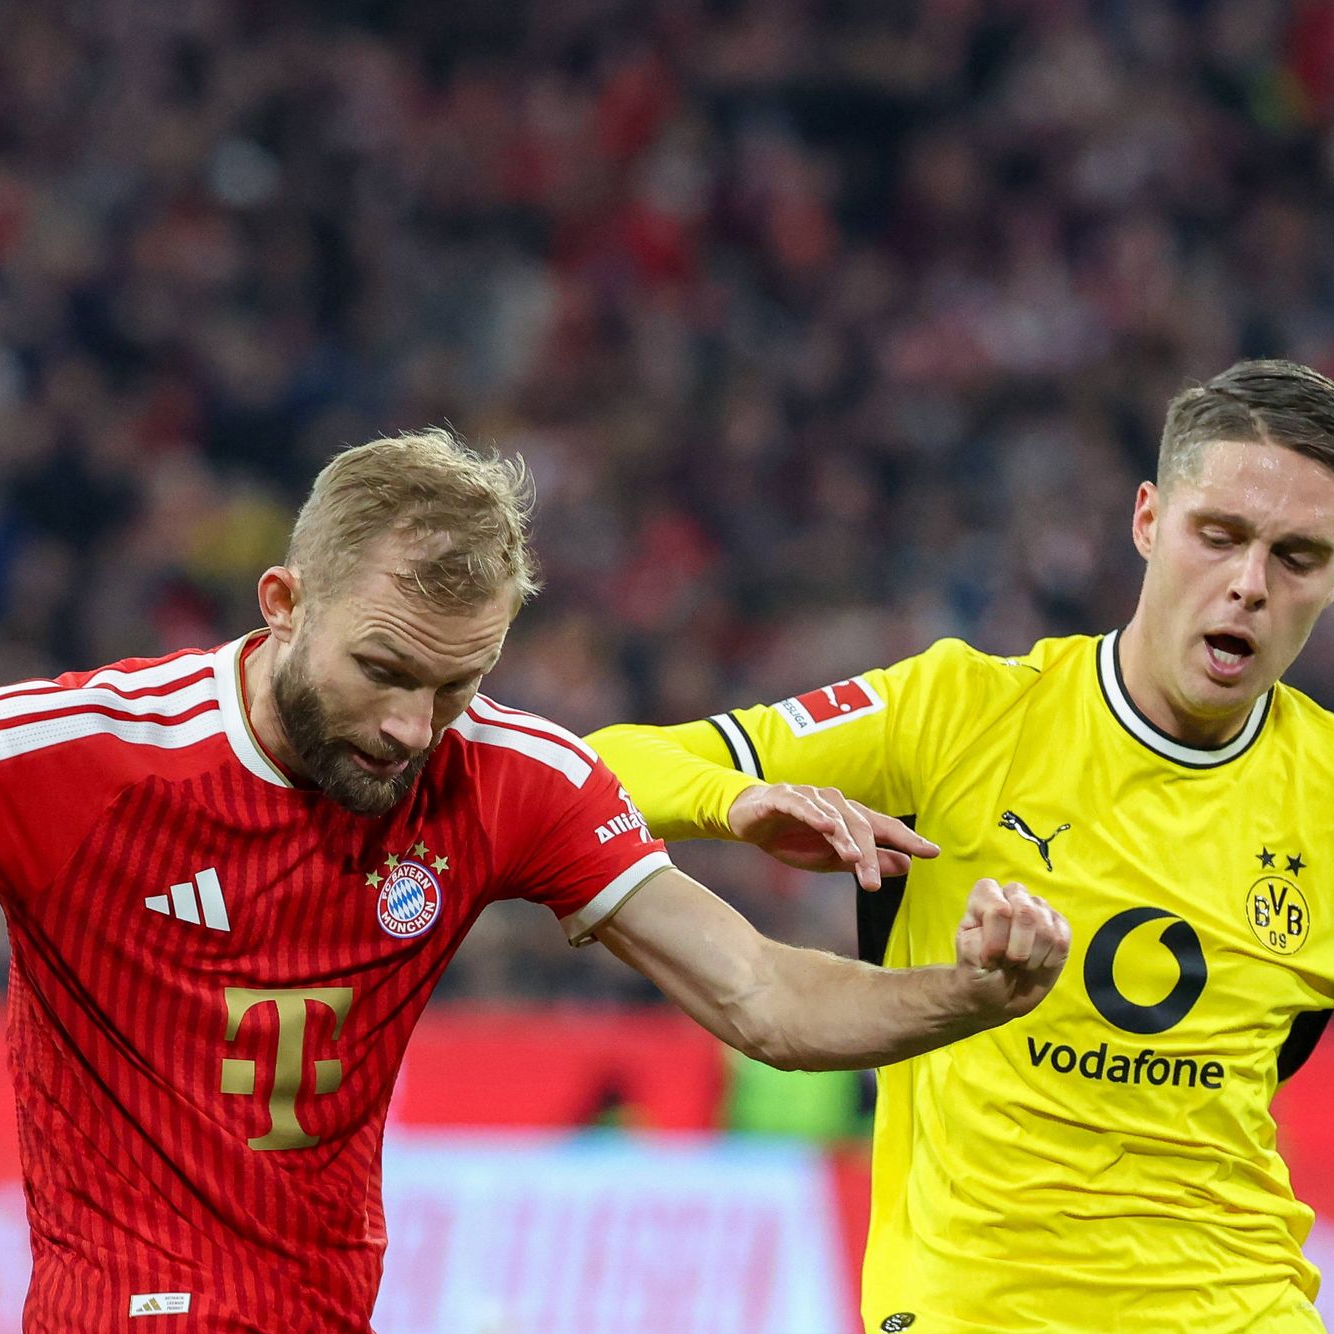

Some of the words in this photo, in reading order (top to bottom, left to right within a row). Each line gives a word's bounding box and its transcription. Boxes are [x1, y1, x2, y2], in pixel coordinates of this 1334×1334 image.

[391, 866, 432, 890] BAYERN
[1254, 881, 1304, 937] BVB
[220, 986, 353, 1151] T
[1027, 1036, 1225, 1089] vodafone
